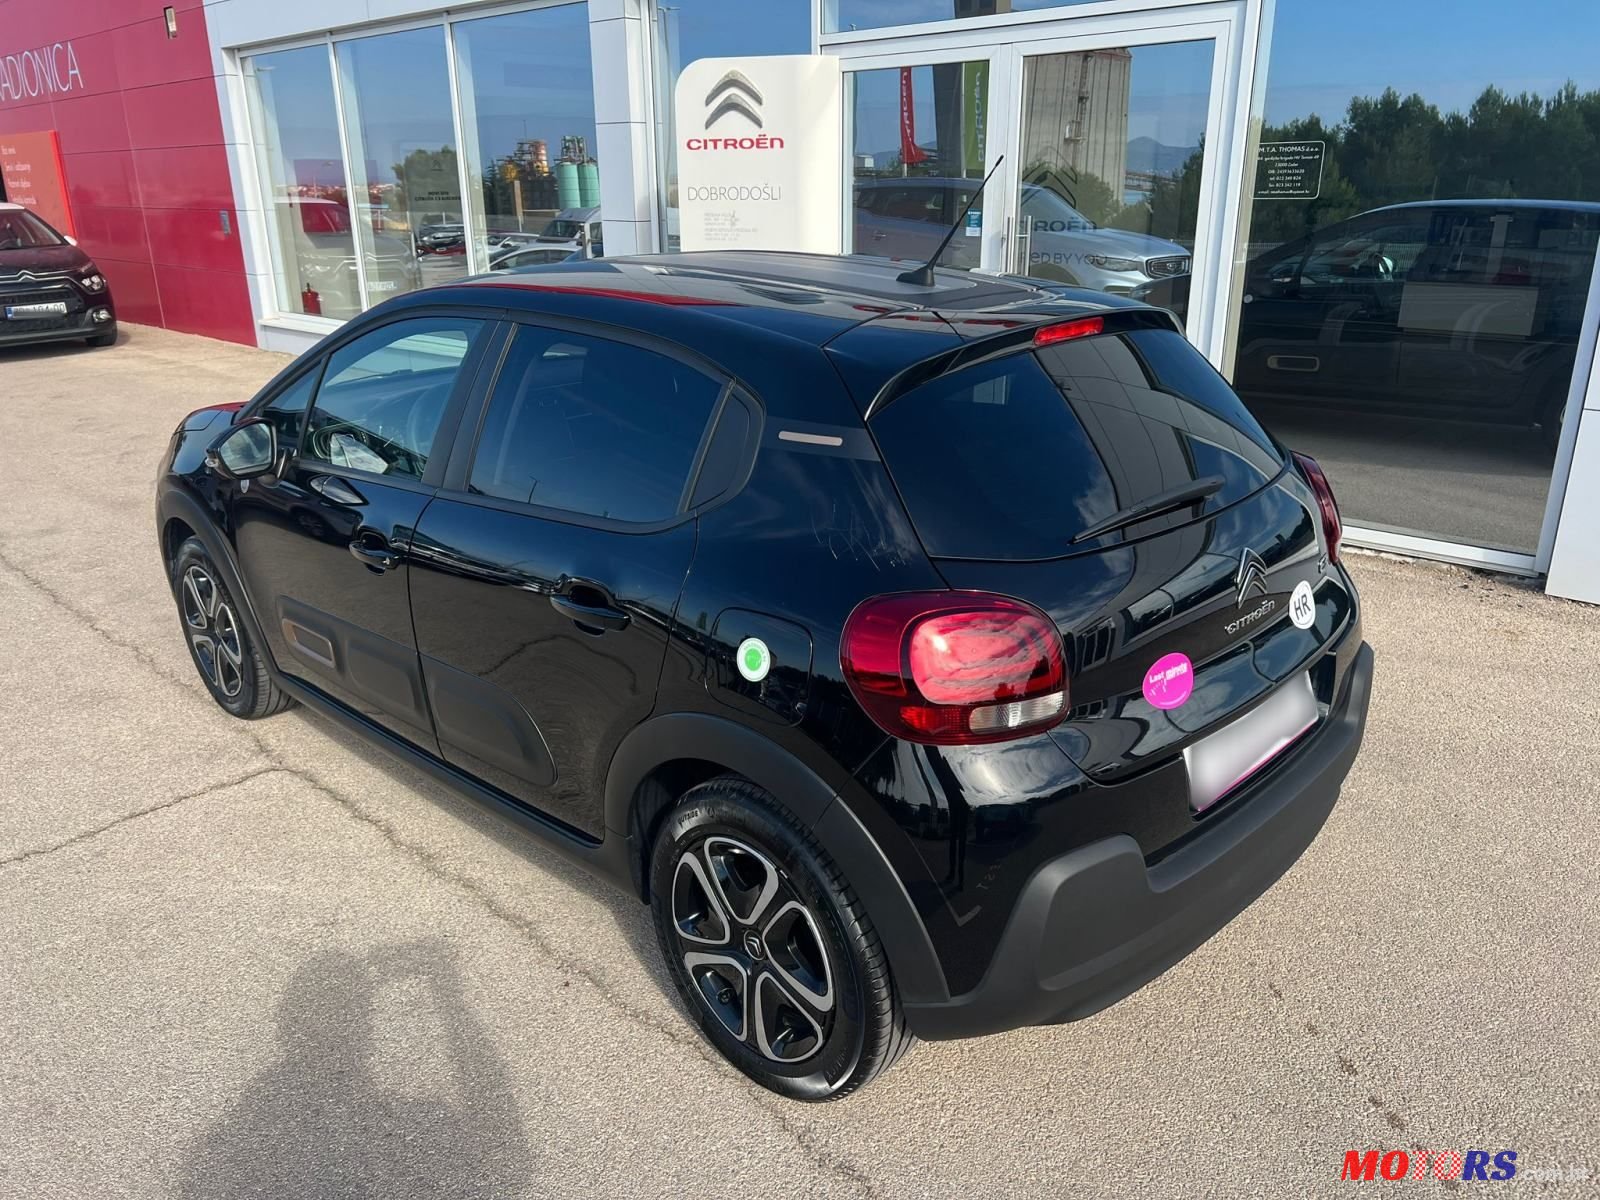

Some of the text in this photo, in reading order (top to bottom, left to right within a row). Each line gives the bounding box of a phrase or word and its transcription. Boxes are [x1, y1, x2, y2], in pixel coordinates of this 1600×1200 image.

[0, 41, 84, 101] ADIONICA
[686, 134, 785, 151] CITROËN
[687, 183, 782, 201] DOBRODOŠLI
[1053, 252, 1072, 265] BY
[1073, 252, 1108, 266] YOU
[1293, 593, 1311, 621] HR
[1226, 600, 1276, 634] CITROËN
[1149, 671, 1165, 684] Last
